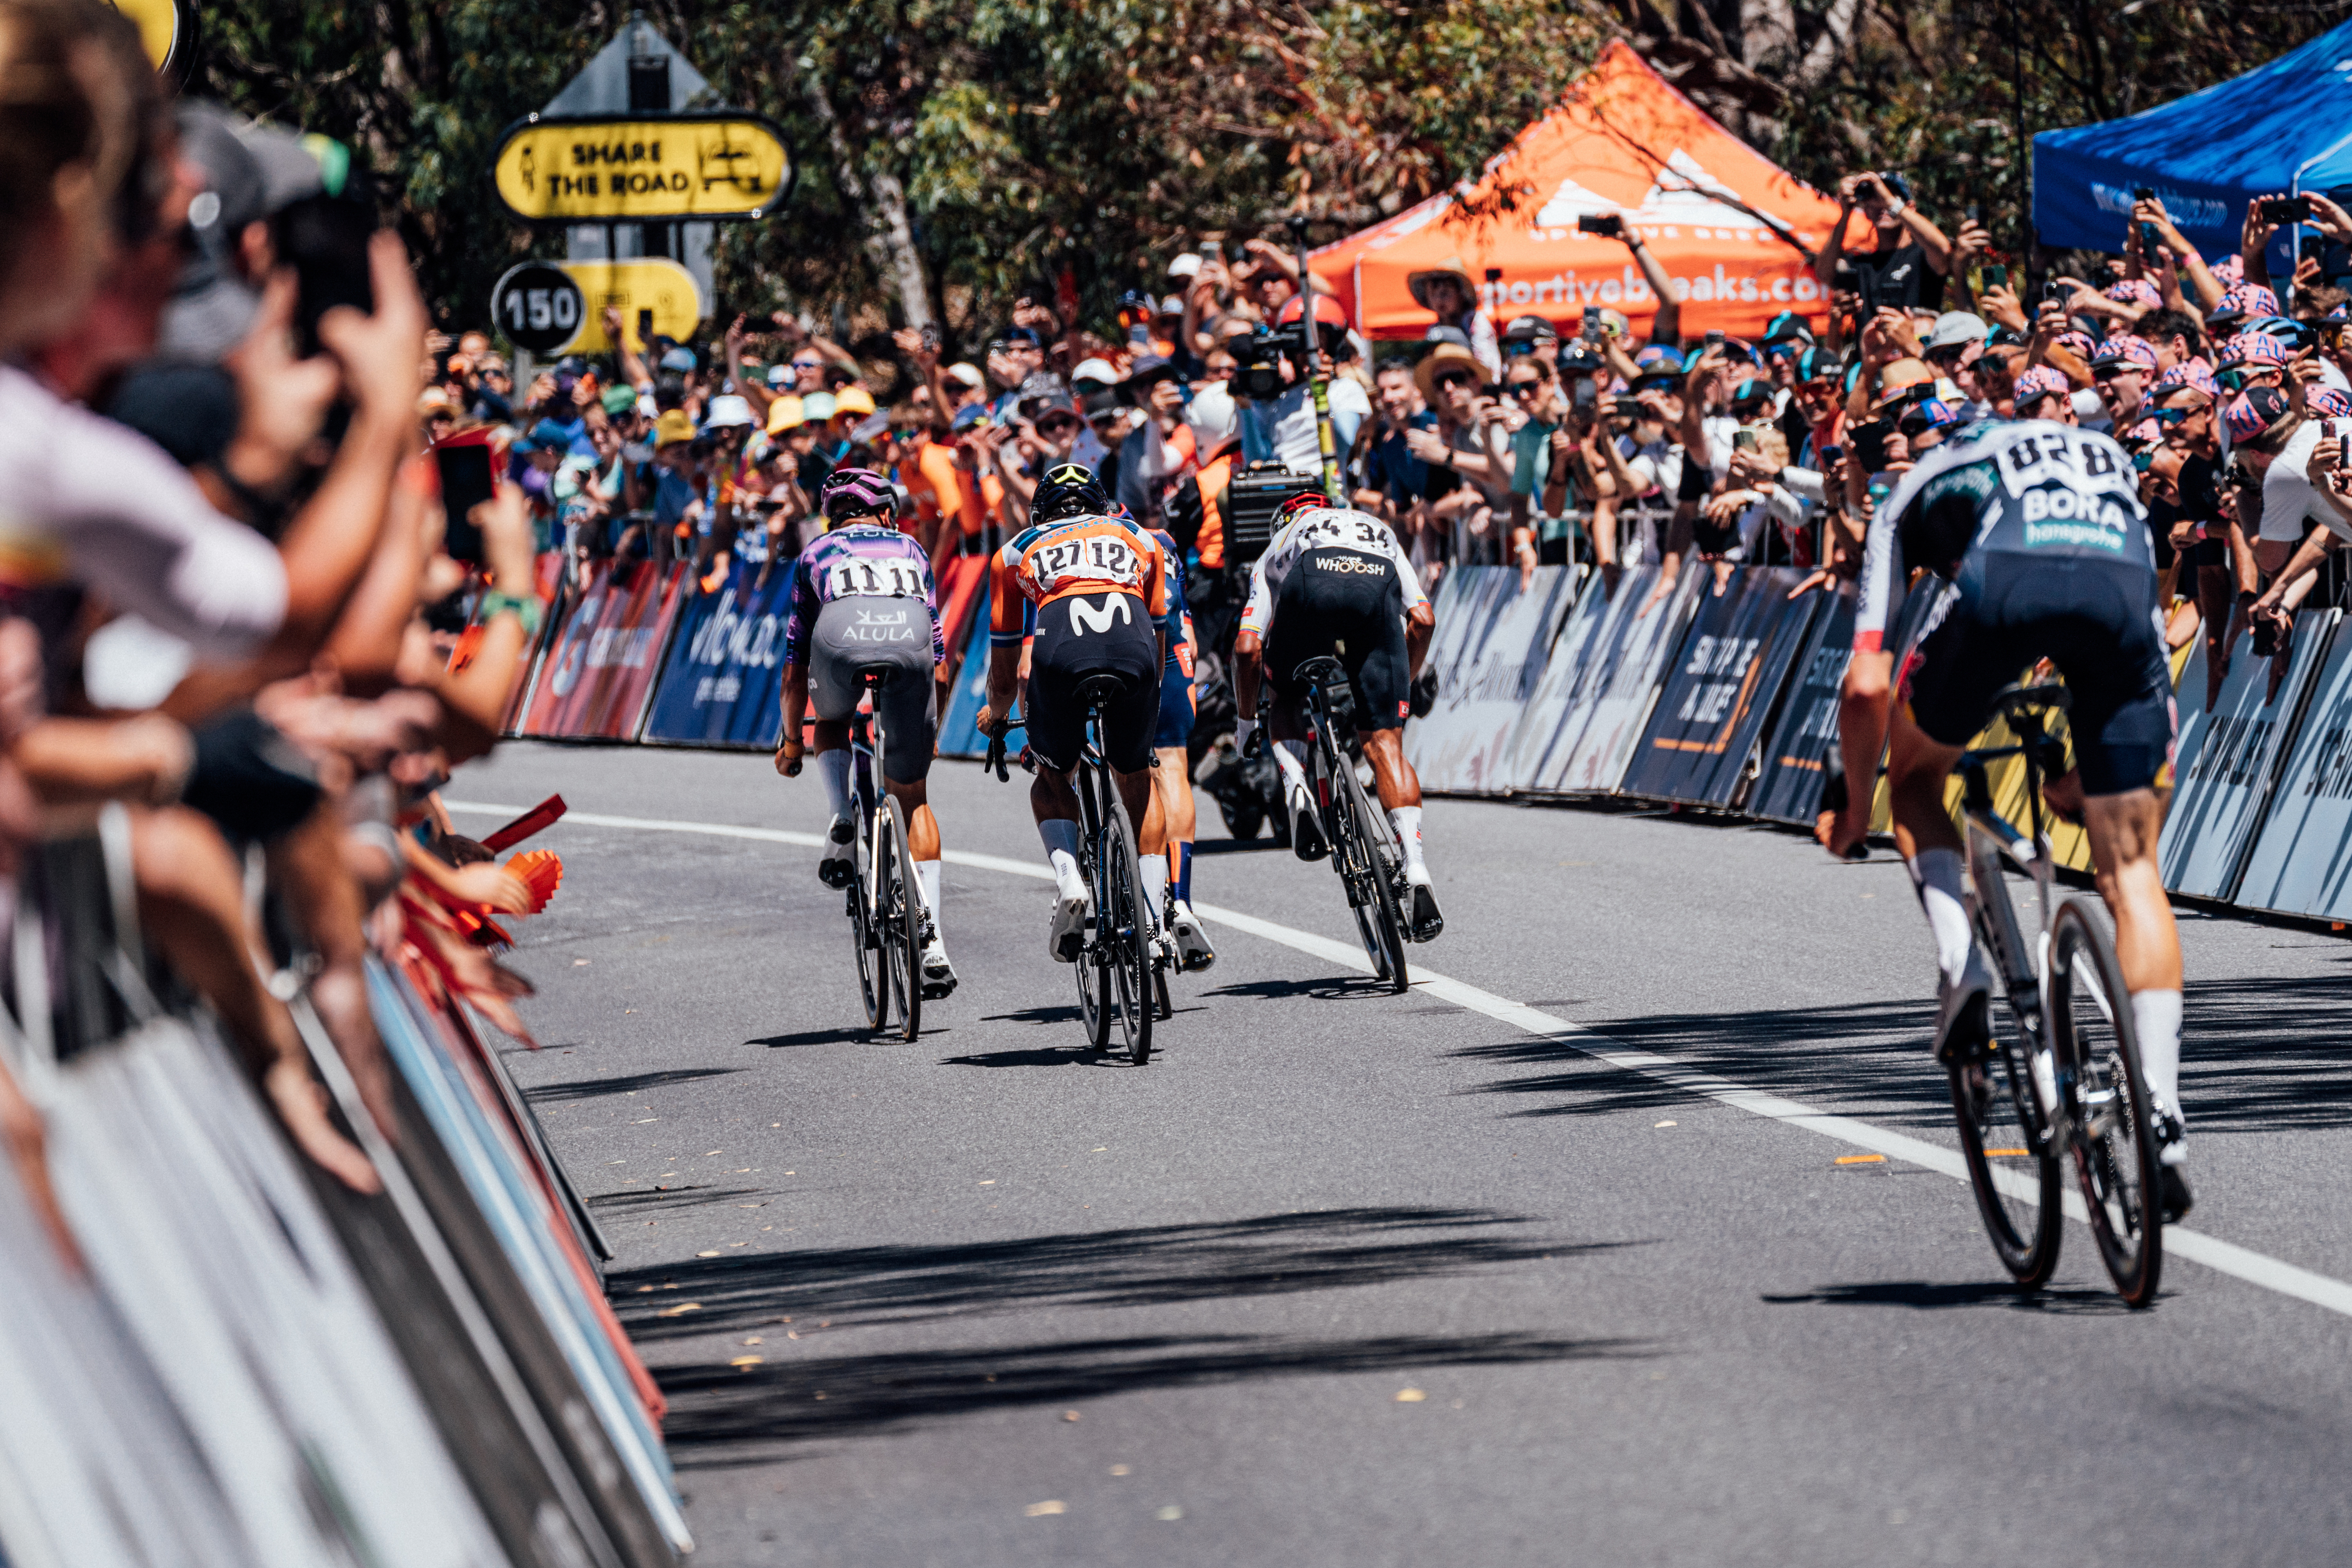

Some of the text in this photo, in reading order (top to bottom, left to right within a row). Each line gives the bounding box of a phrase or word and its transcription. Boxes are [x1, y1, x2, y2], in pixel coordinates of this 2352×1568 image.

[572, 142, 662, 165] SHARE
[548, 172, 688, 197] THE ROAD
[506, 286, 576, 331] 150
[2022, 488, 2128, 533] BORA
[1039, 518, 1123, 543] santos
[2026, 523, 2123, 549] hansgrohe
[1031, 540, 1080, 584] 127
[1316, 557, 1385, 576] WHOOSH
[839, 565, 880, 594] 11
[889, 567, 924, 596] 11
[842, 626, 914, 642] ALULA
